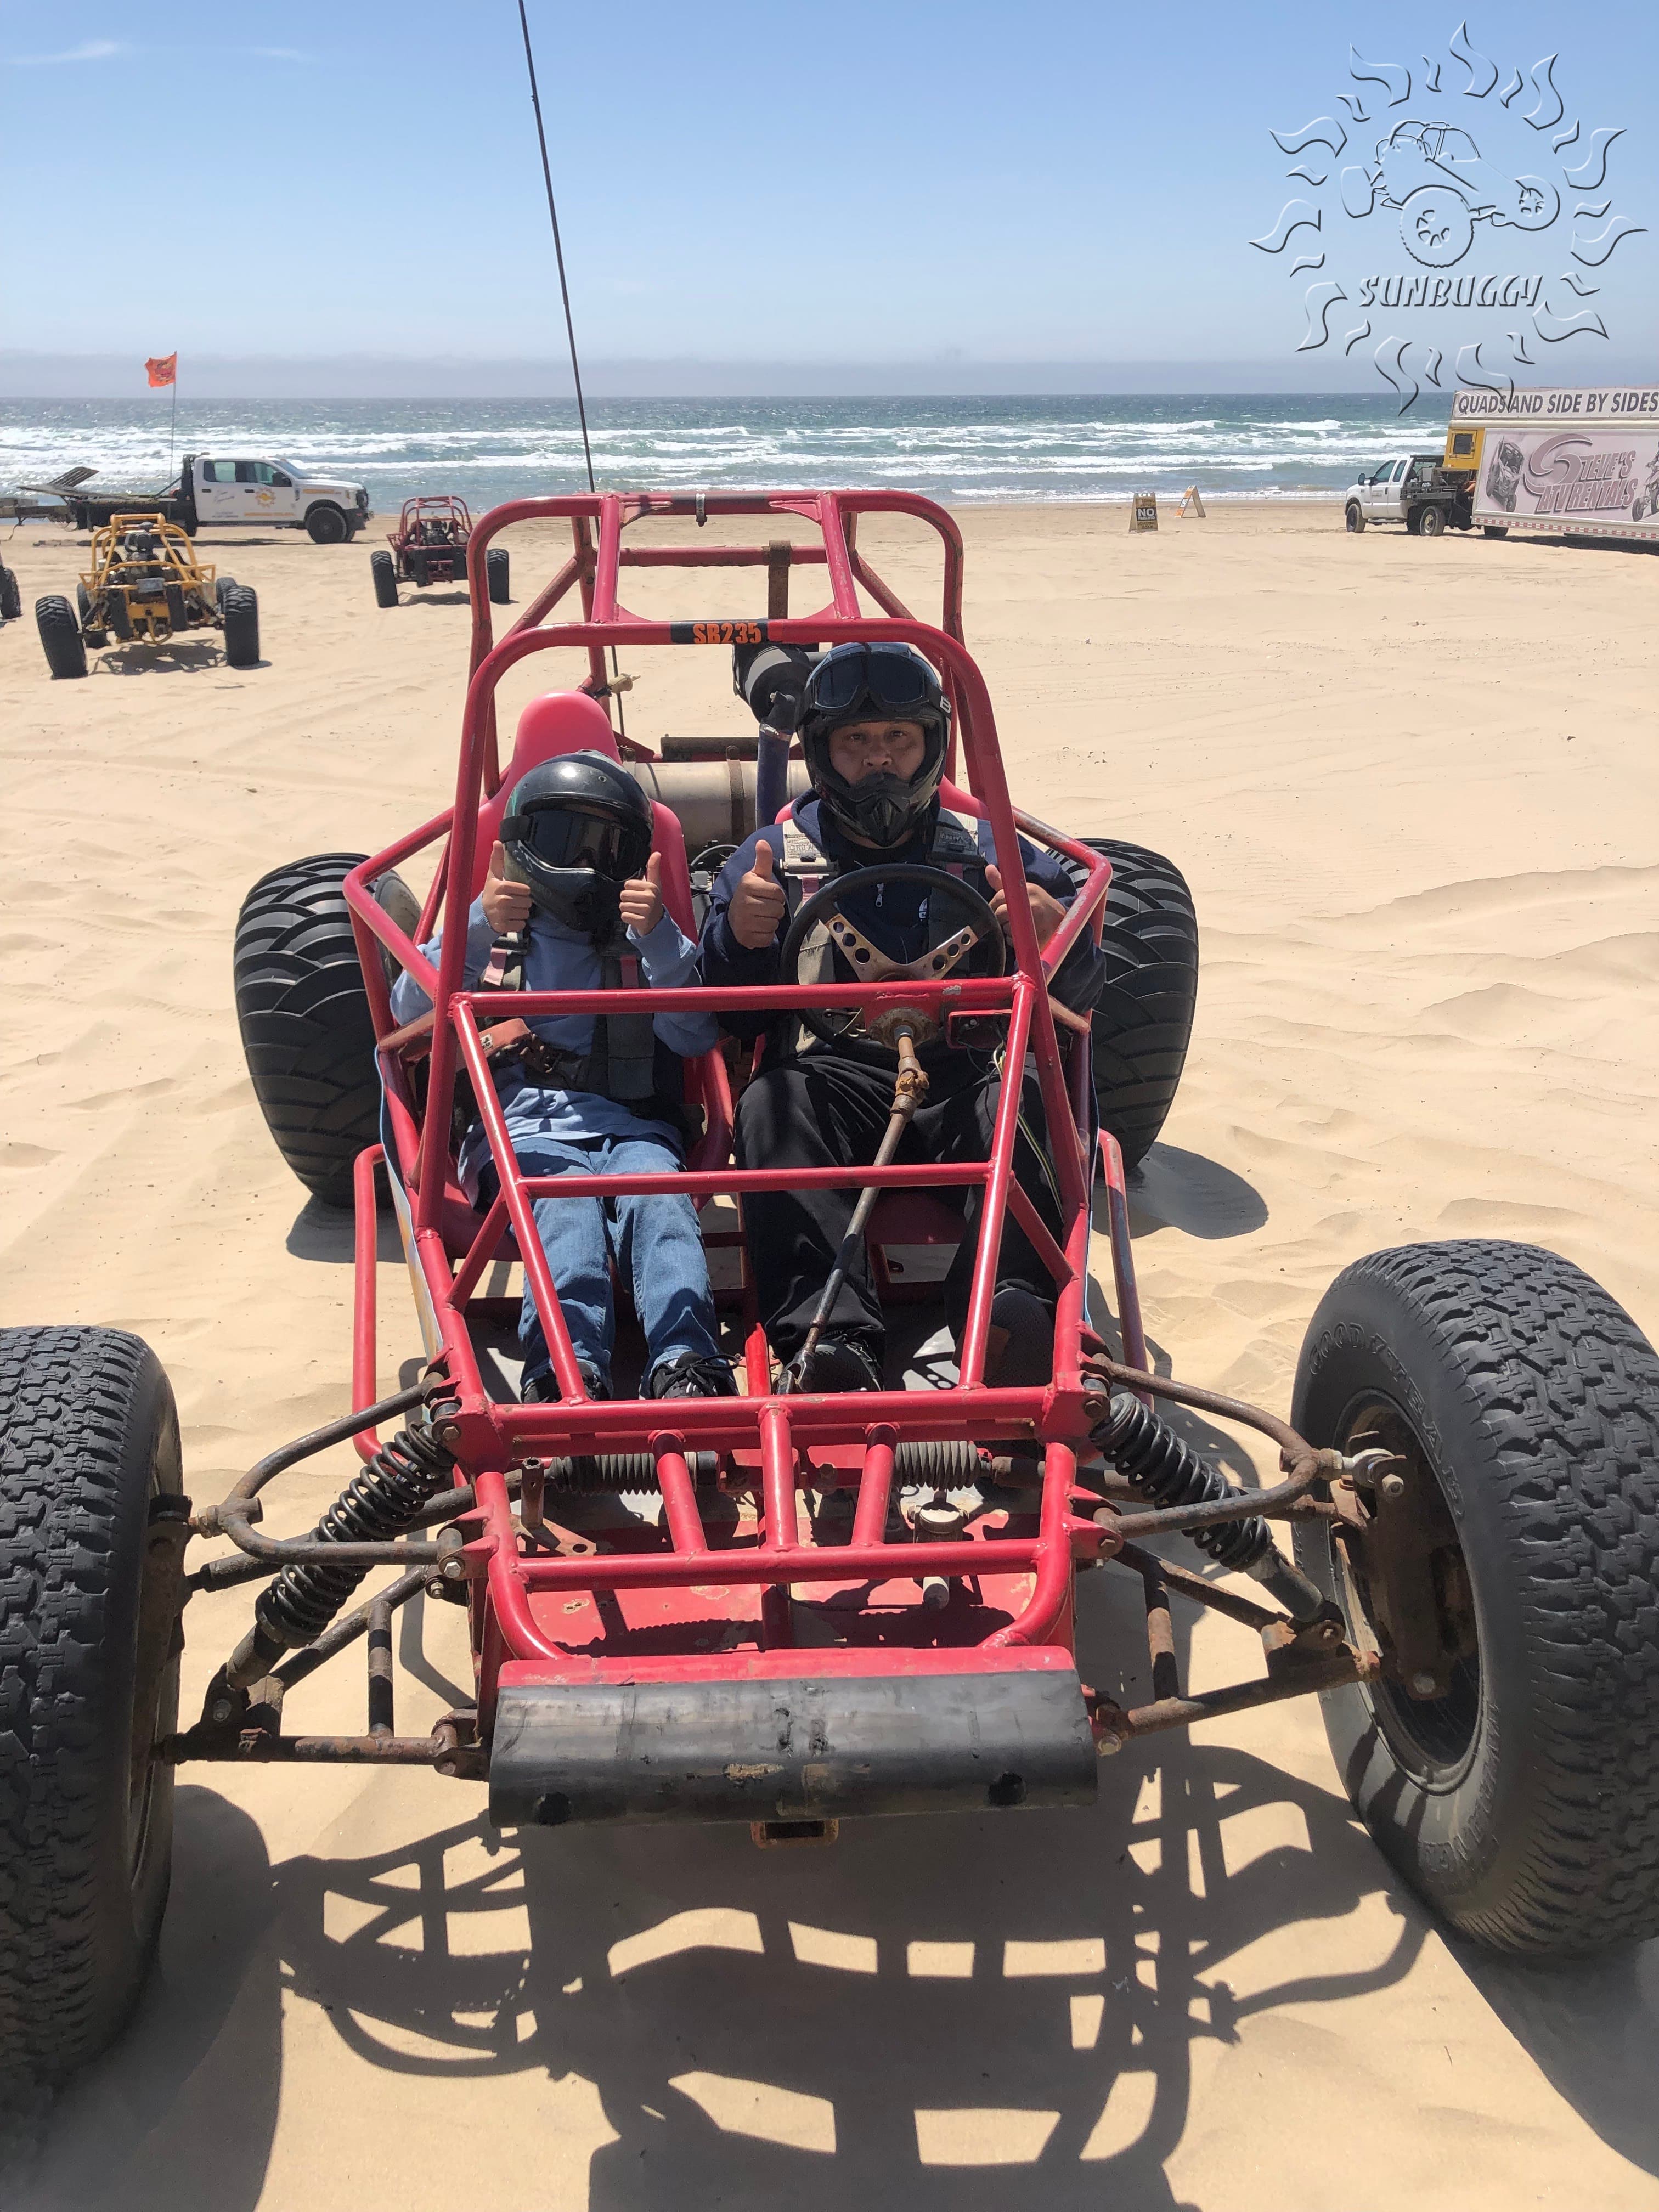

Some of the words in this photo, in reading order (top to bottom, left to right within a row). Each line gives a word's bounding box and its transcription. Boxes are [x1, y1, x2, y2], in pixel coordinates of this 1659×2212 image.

[1458, 394, 1506, 415] QUADS
[1509, 394, 1543, 413] AND
[1547, 393, 1583, 413] SIDE
[1585, 393, 1609, 413] BY
[1610, 391, 1659, 413] SIDES
[1536, 482, 1573, 513] ATV
[1566, 478, 1639, 511] RENTALS
[1138, 507, 1155, 516] NO
[693, 623, 761, 644] SB235
